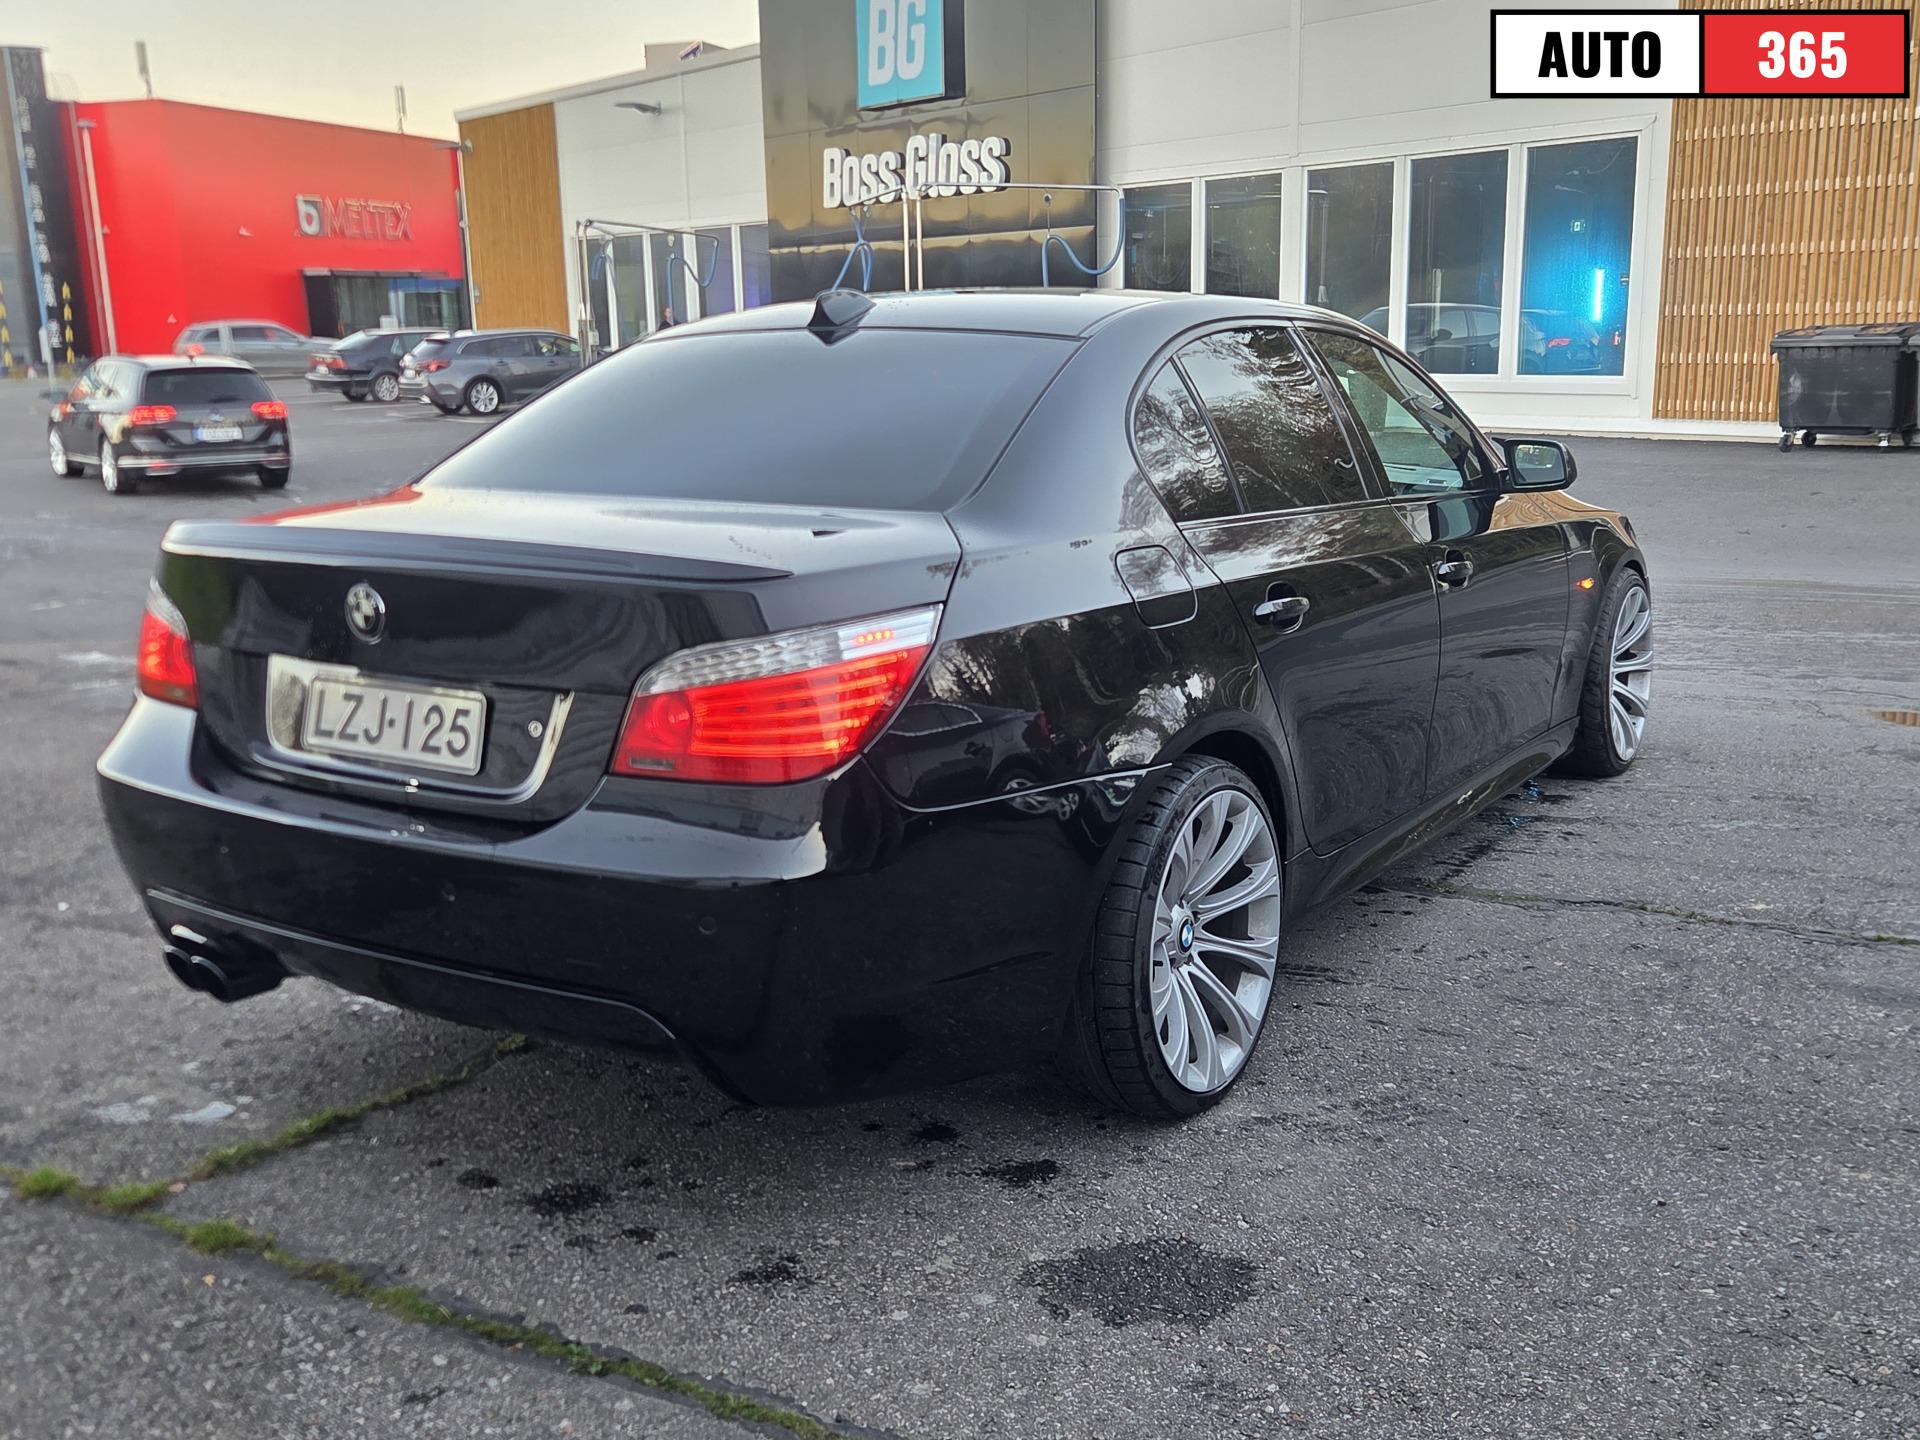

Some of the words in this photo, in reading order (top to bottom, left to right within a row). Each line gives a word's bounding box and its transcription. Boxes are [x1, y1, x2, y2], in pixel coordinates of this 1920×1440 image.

[868, 0, 926, 87] BG
[823, 147, 904, 209] Boss
[905, 133, 1008, 200] Gloss
